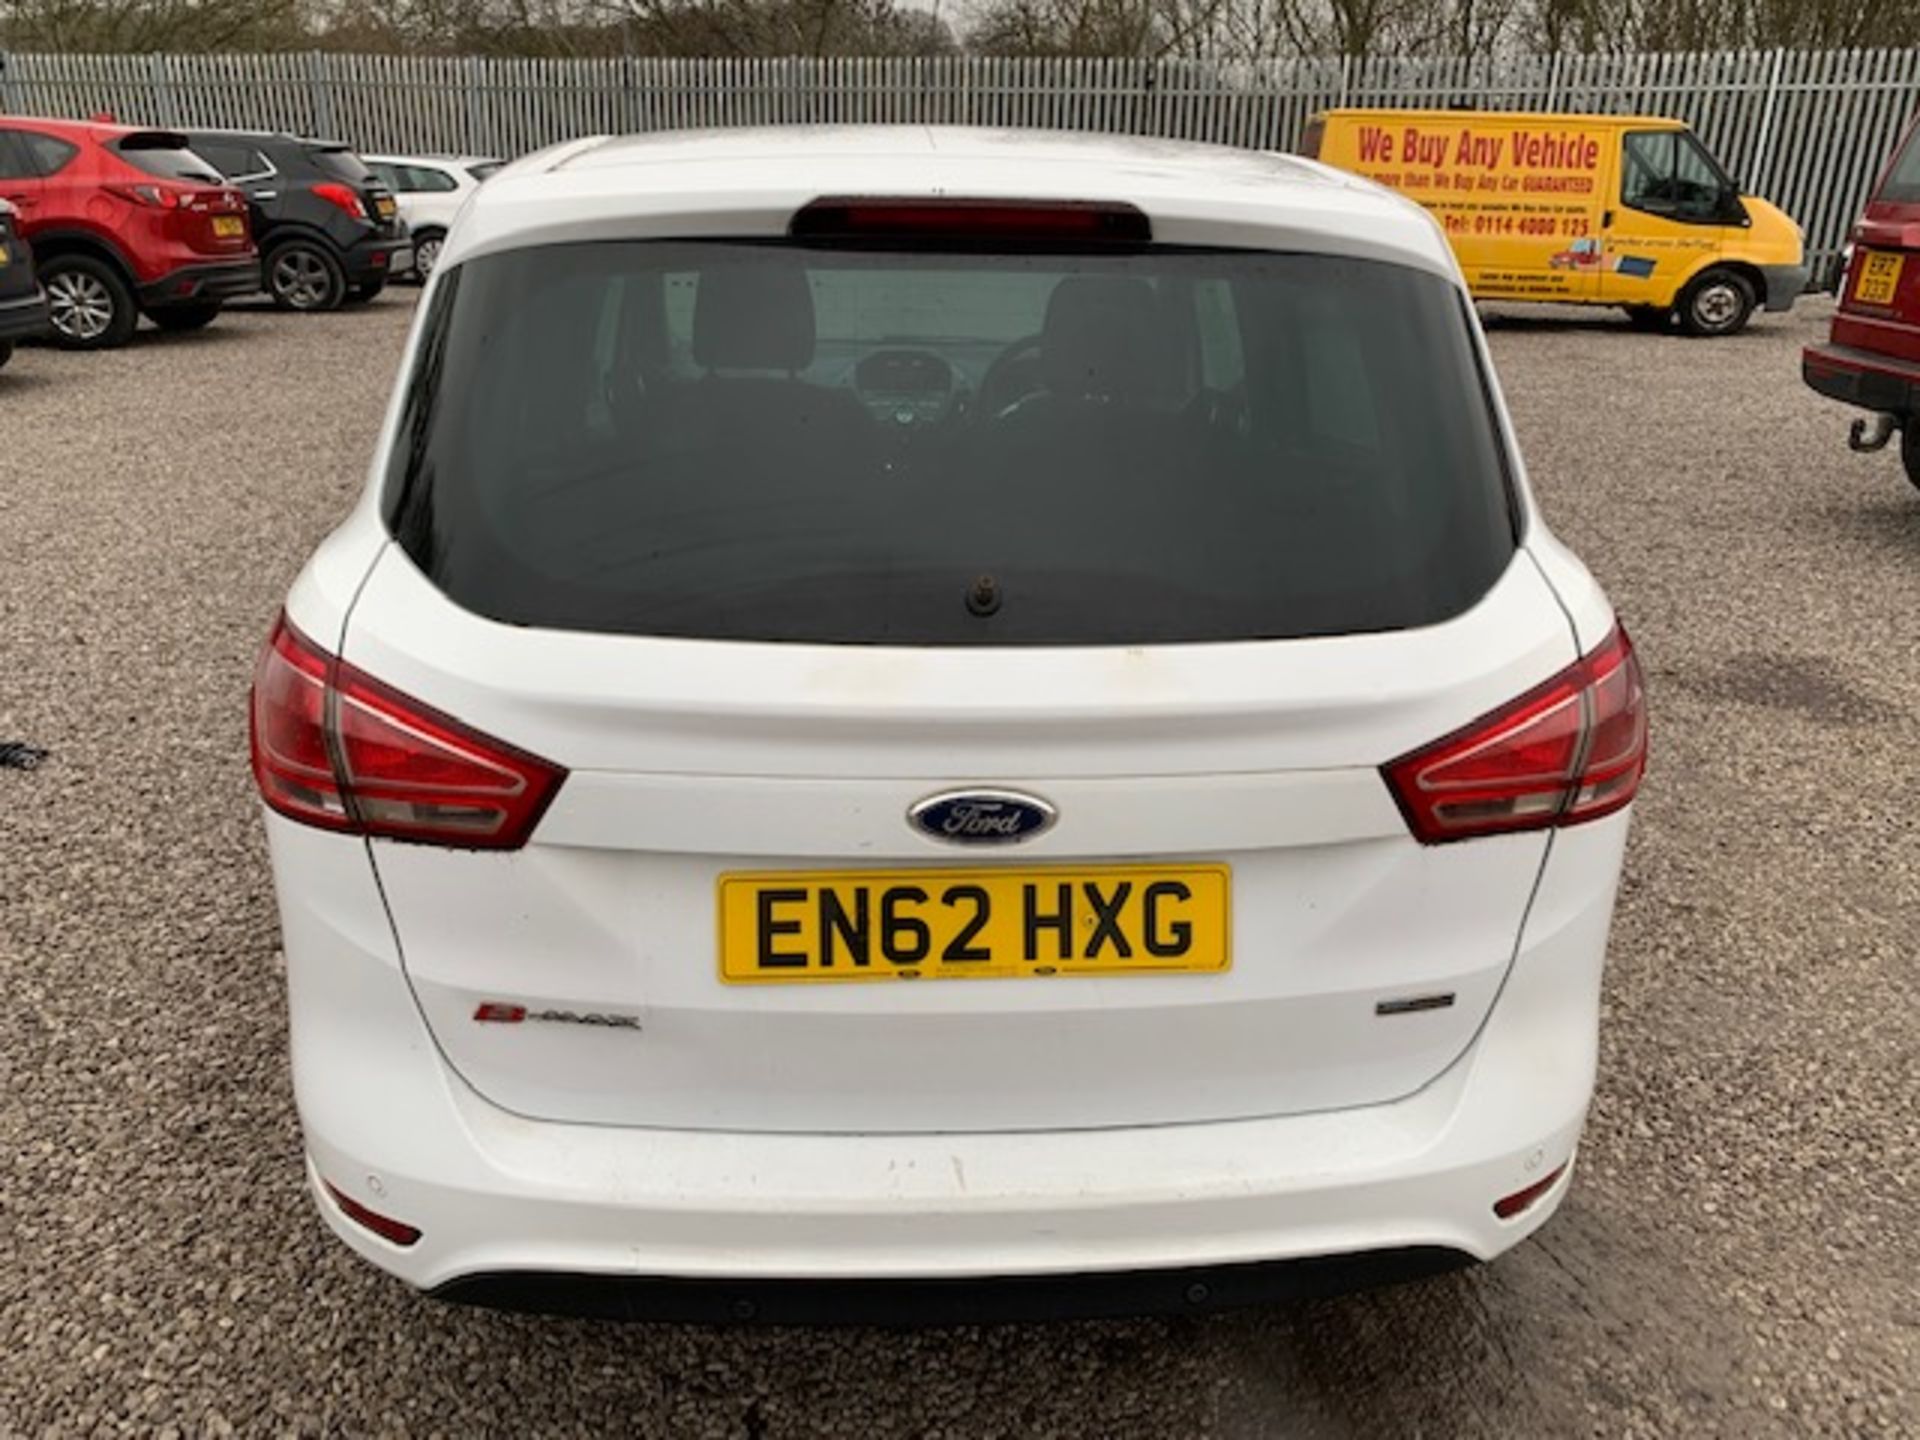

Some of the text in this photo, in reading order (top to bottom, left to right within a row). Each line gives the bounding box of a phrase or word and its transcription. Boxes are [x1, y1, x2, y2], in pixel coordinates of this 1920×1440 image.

[1359, 127, 1599, 170] We Buy Any Vehicle
[1403, 172, 1430, 188] than
[1433, 173, 1450, 189] We
[1454, 173, 1476, 192] Buy
[1477, 174, 1499, 192] Any
[1501, 175, 1519, 191] Car
[1522, 176, 1594, 194] GUARANTEED
[1445, 214, 1589, 237] Tel: 0114 4000 125
[943, 803, 1022, 833] Ford
[756, 881, 1193, 969] EN62 HXG
